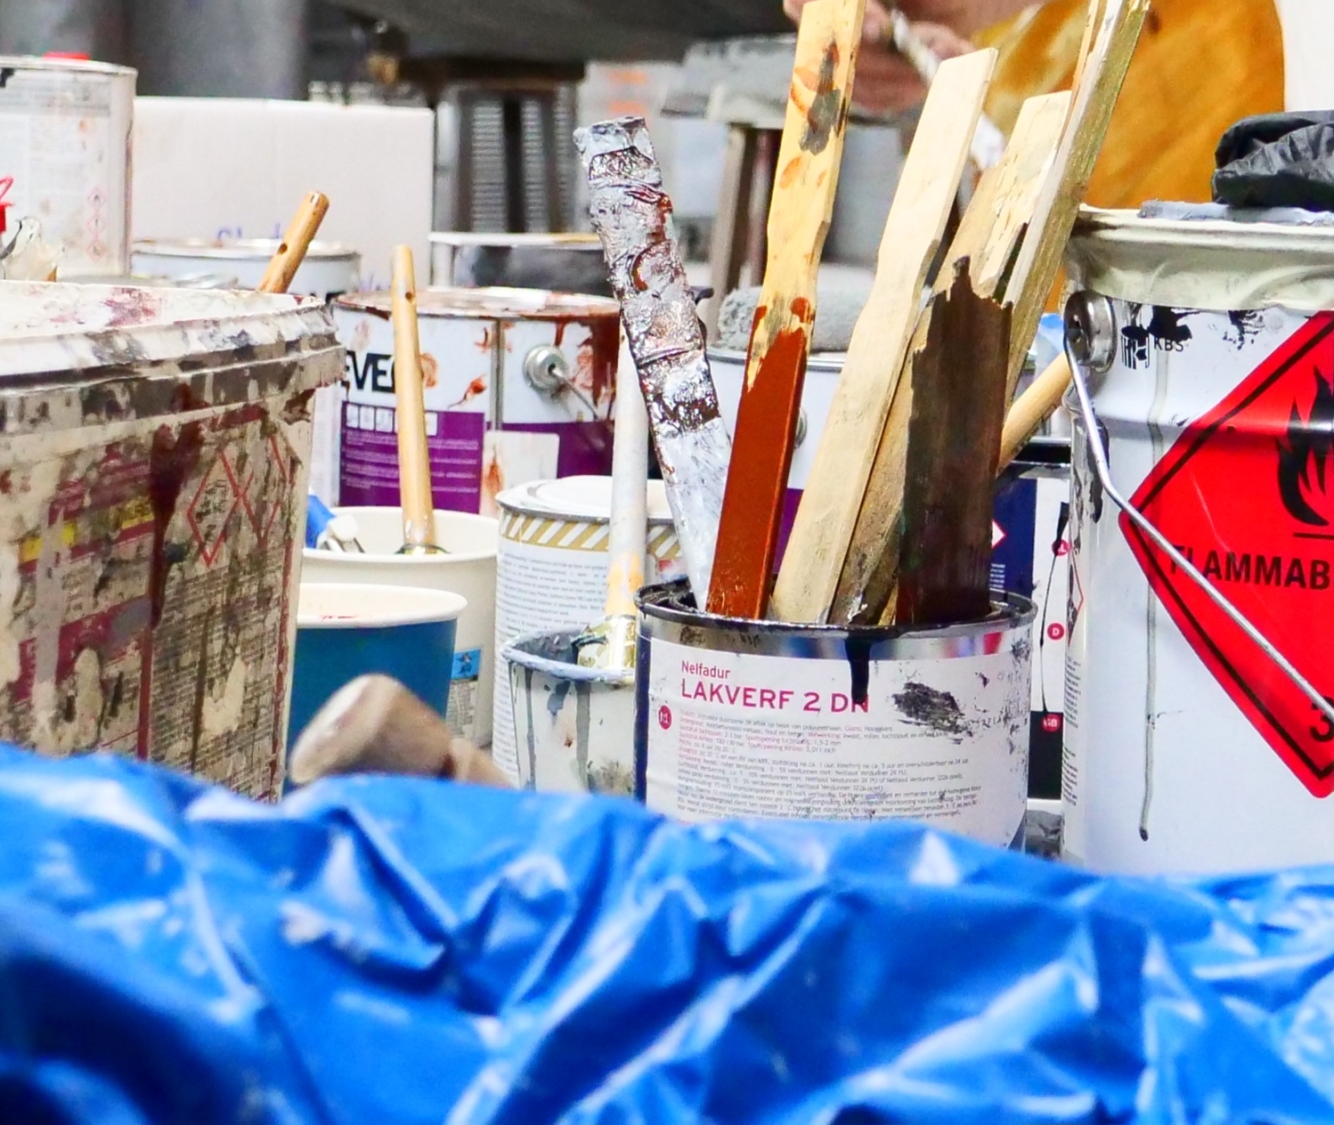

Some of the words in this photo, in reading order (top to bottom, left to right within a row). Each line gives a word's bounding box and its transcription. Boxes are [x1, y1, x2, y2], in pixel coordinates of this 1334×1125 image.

[681, 660, 731, 679] Nelfadur
[681, 678, 795, 710] LAKVERF
[802, 692, 821, 713] 2
